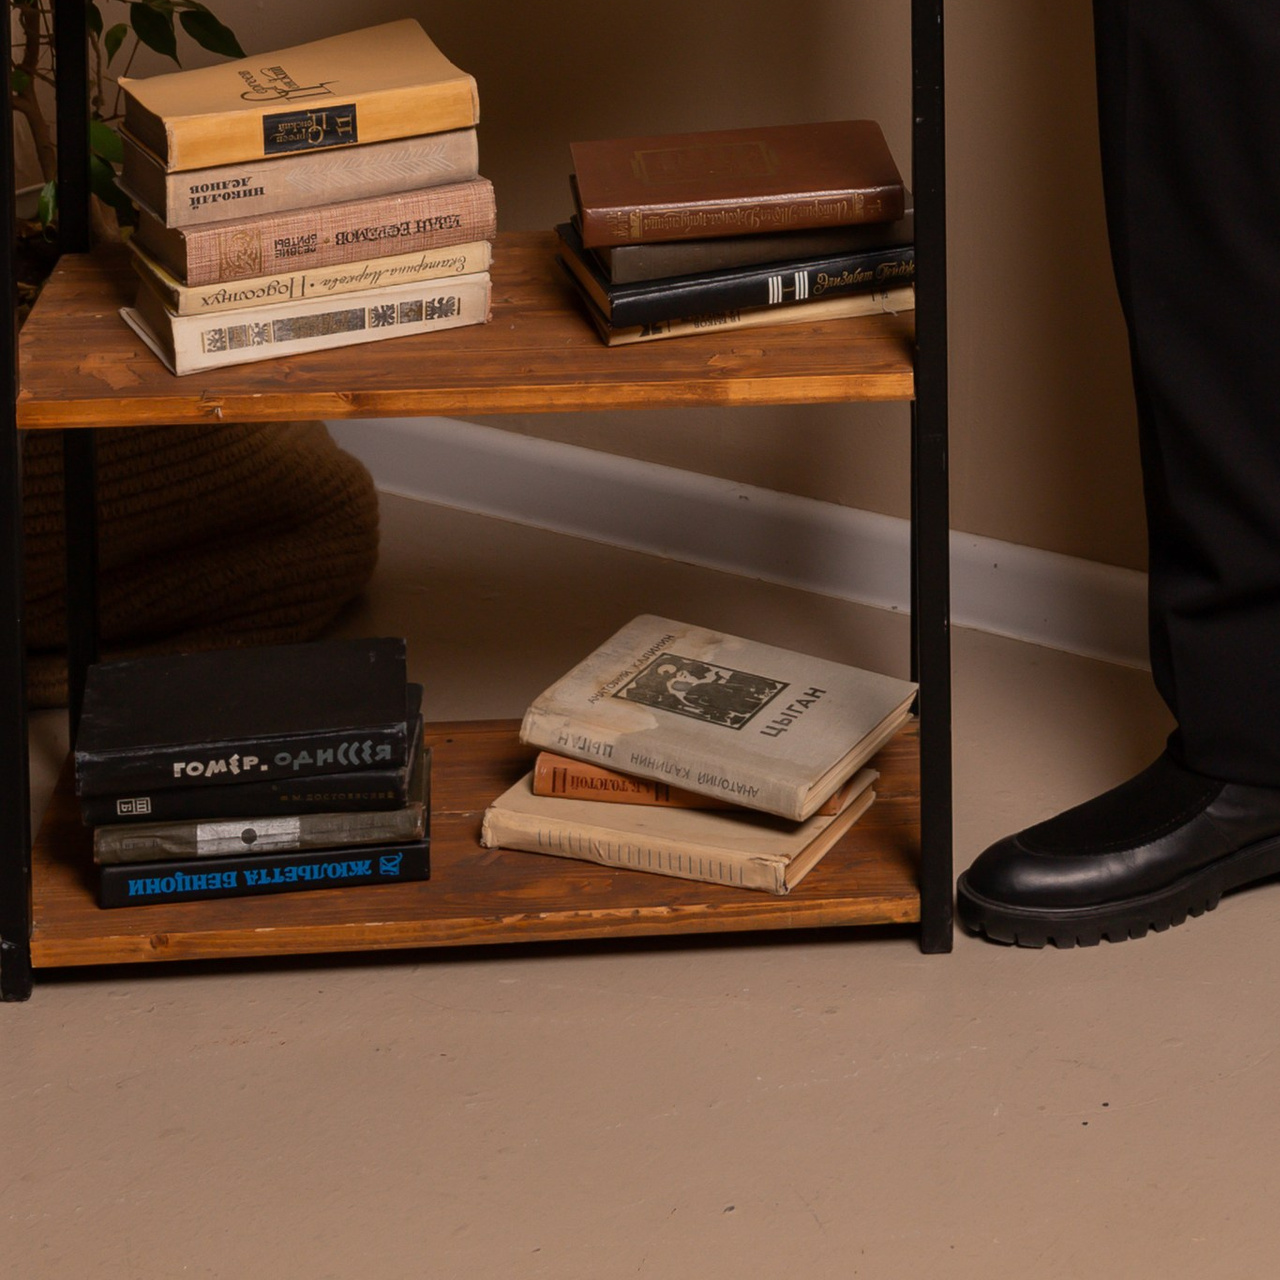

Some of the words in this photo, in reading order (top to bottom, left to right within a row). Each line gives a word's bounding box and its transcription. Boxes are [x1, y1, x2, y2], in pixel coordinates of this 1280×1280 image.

[189, 186, 265, 211] НИКОЛАЙ
[273, 233, 319, 249] БРИТВЫ
[334, 219, 411, 247] ЕФРЕМОВ
[411, 213, 462, 237] ИВАН
[274, 243, 318, 259] ЛЕЗВИЕ
[319, 261, 391, 287] Маркова
[388, 254, 467, 281] Екатерина
[812, 267, 874, 295] Элизабет
[199, 276, 306, 309] Подсолнух
[586, 669, 632, 706] АНАТОЛИЙ
[630, 633, 676, 671] КАЛИНИН
[759, 685, 827, 742] ЦЫГАН
[274, 741, 393, 774] ОДИССЕЯ
[555, 731, 614, 758] ЦЫГАН
[629, 751, 691, 781] КАЛИНИН
[697, 770, 760, 799] АНАТОЛИЙ
[127, 869, 238, 897] БЕНЦОНИ
[242, 859, 372, 886] ЖЮЛЬЕТТА
